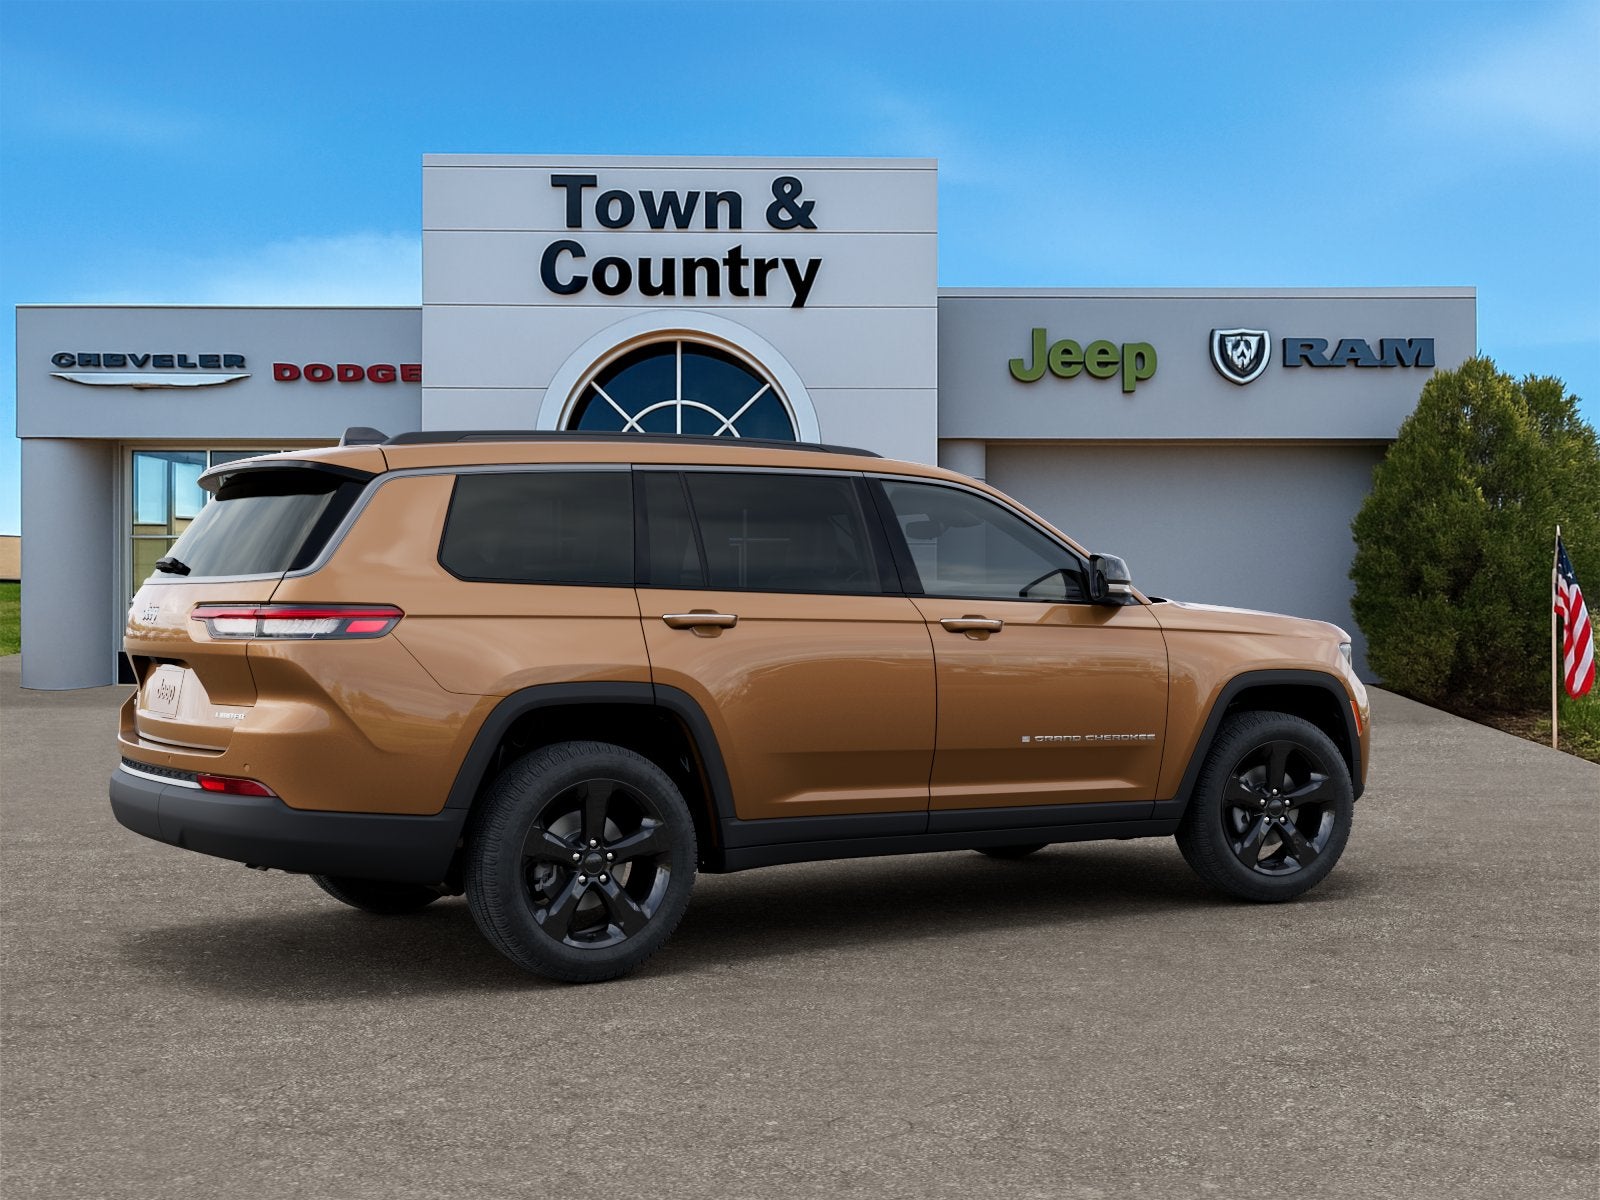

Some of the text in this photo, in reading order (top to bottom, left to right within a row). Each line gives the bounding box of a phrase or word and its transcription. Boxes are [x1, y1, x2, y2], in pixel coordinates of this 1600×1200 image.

[550, 173, 818, 230] Town &
[539, 239, 823, 308] Country
[272, 362, 422, 383] DODGE
[1008, 327, 1158, 394] Jeep
[1282, 337, 1436, 368] RAM
[1085, 733, 1156, 742] CHEROKEE
